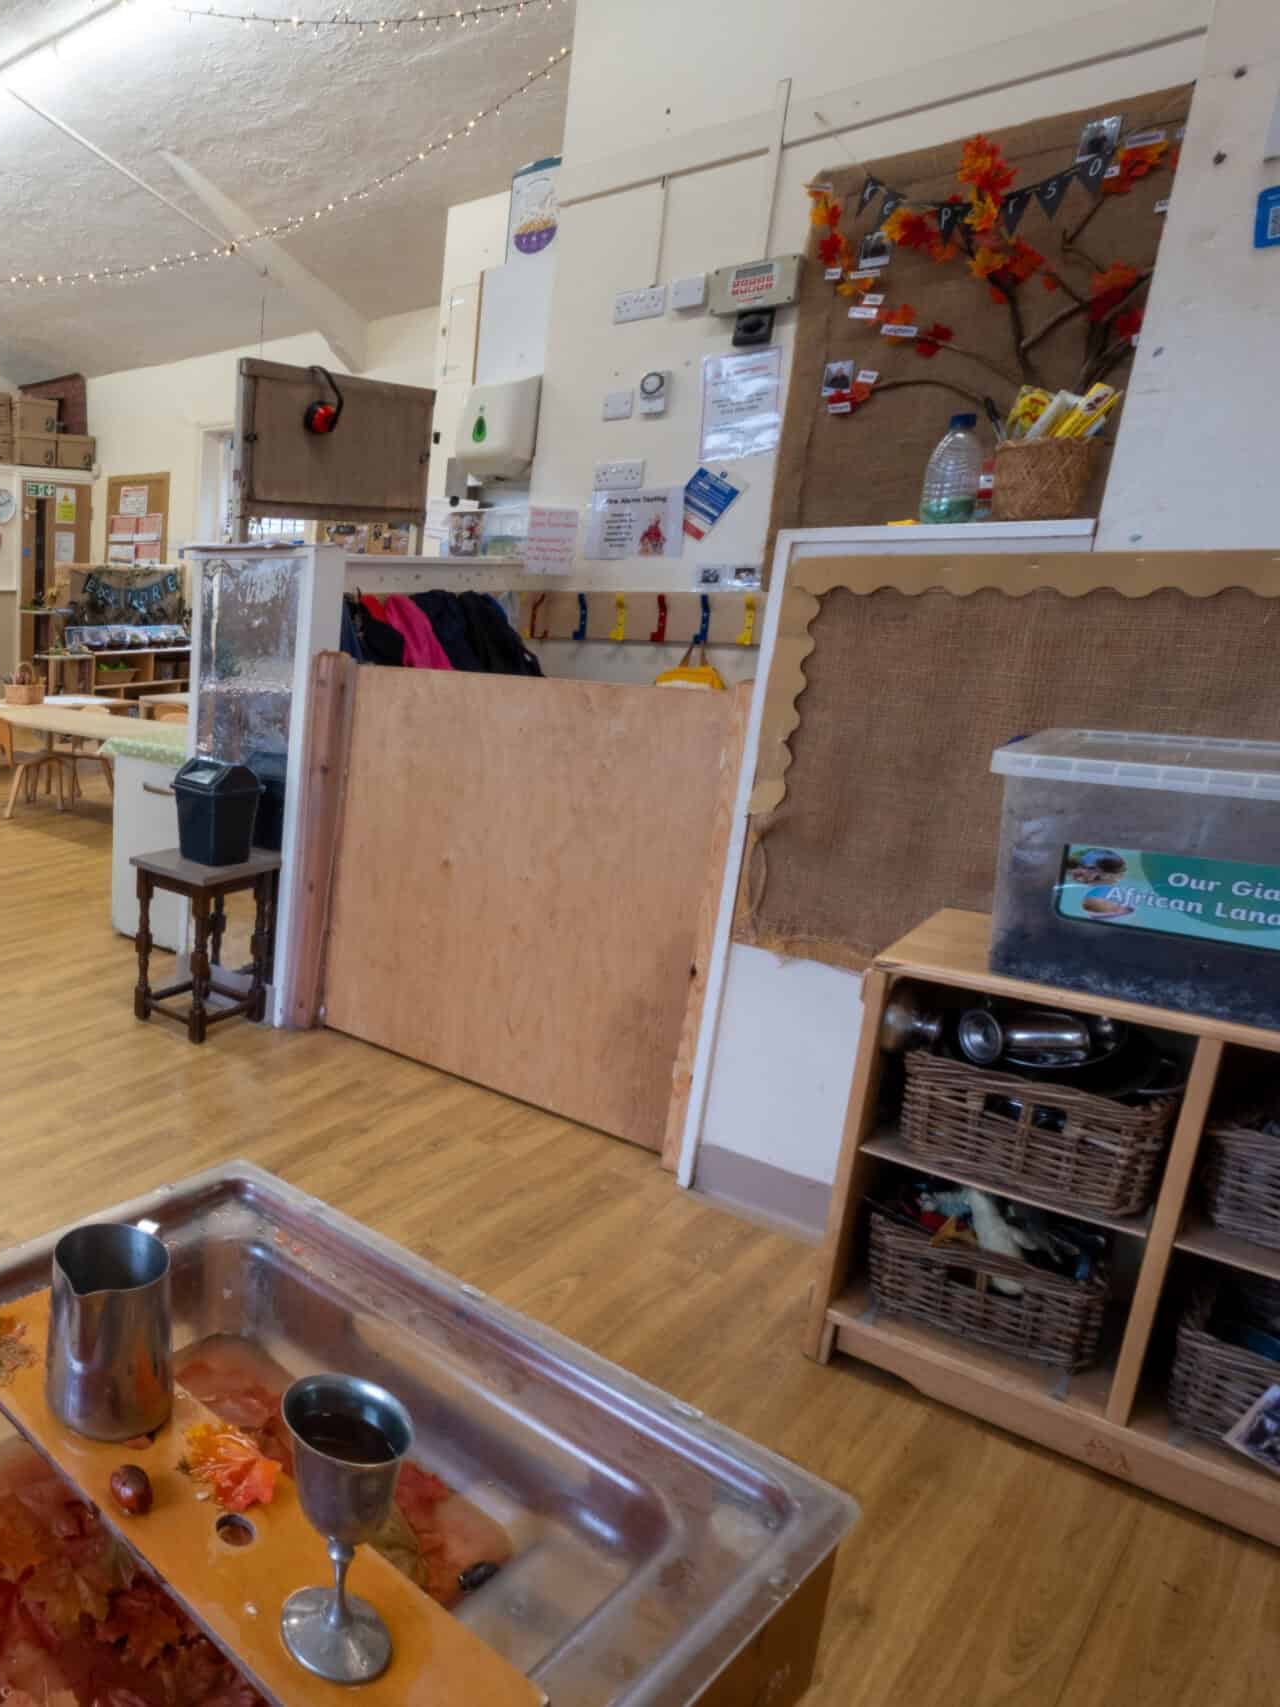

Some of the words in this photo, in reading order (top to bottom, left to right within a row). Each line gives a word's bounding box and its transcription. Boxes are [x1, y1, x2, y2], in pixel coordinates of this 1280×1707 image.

[1167, 872, 1222, 892] Our
[1231, 880, 1280, 901] Gia
[1104, 887, 1204, 915] African
